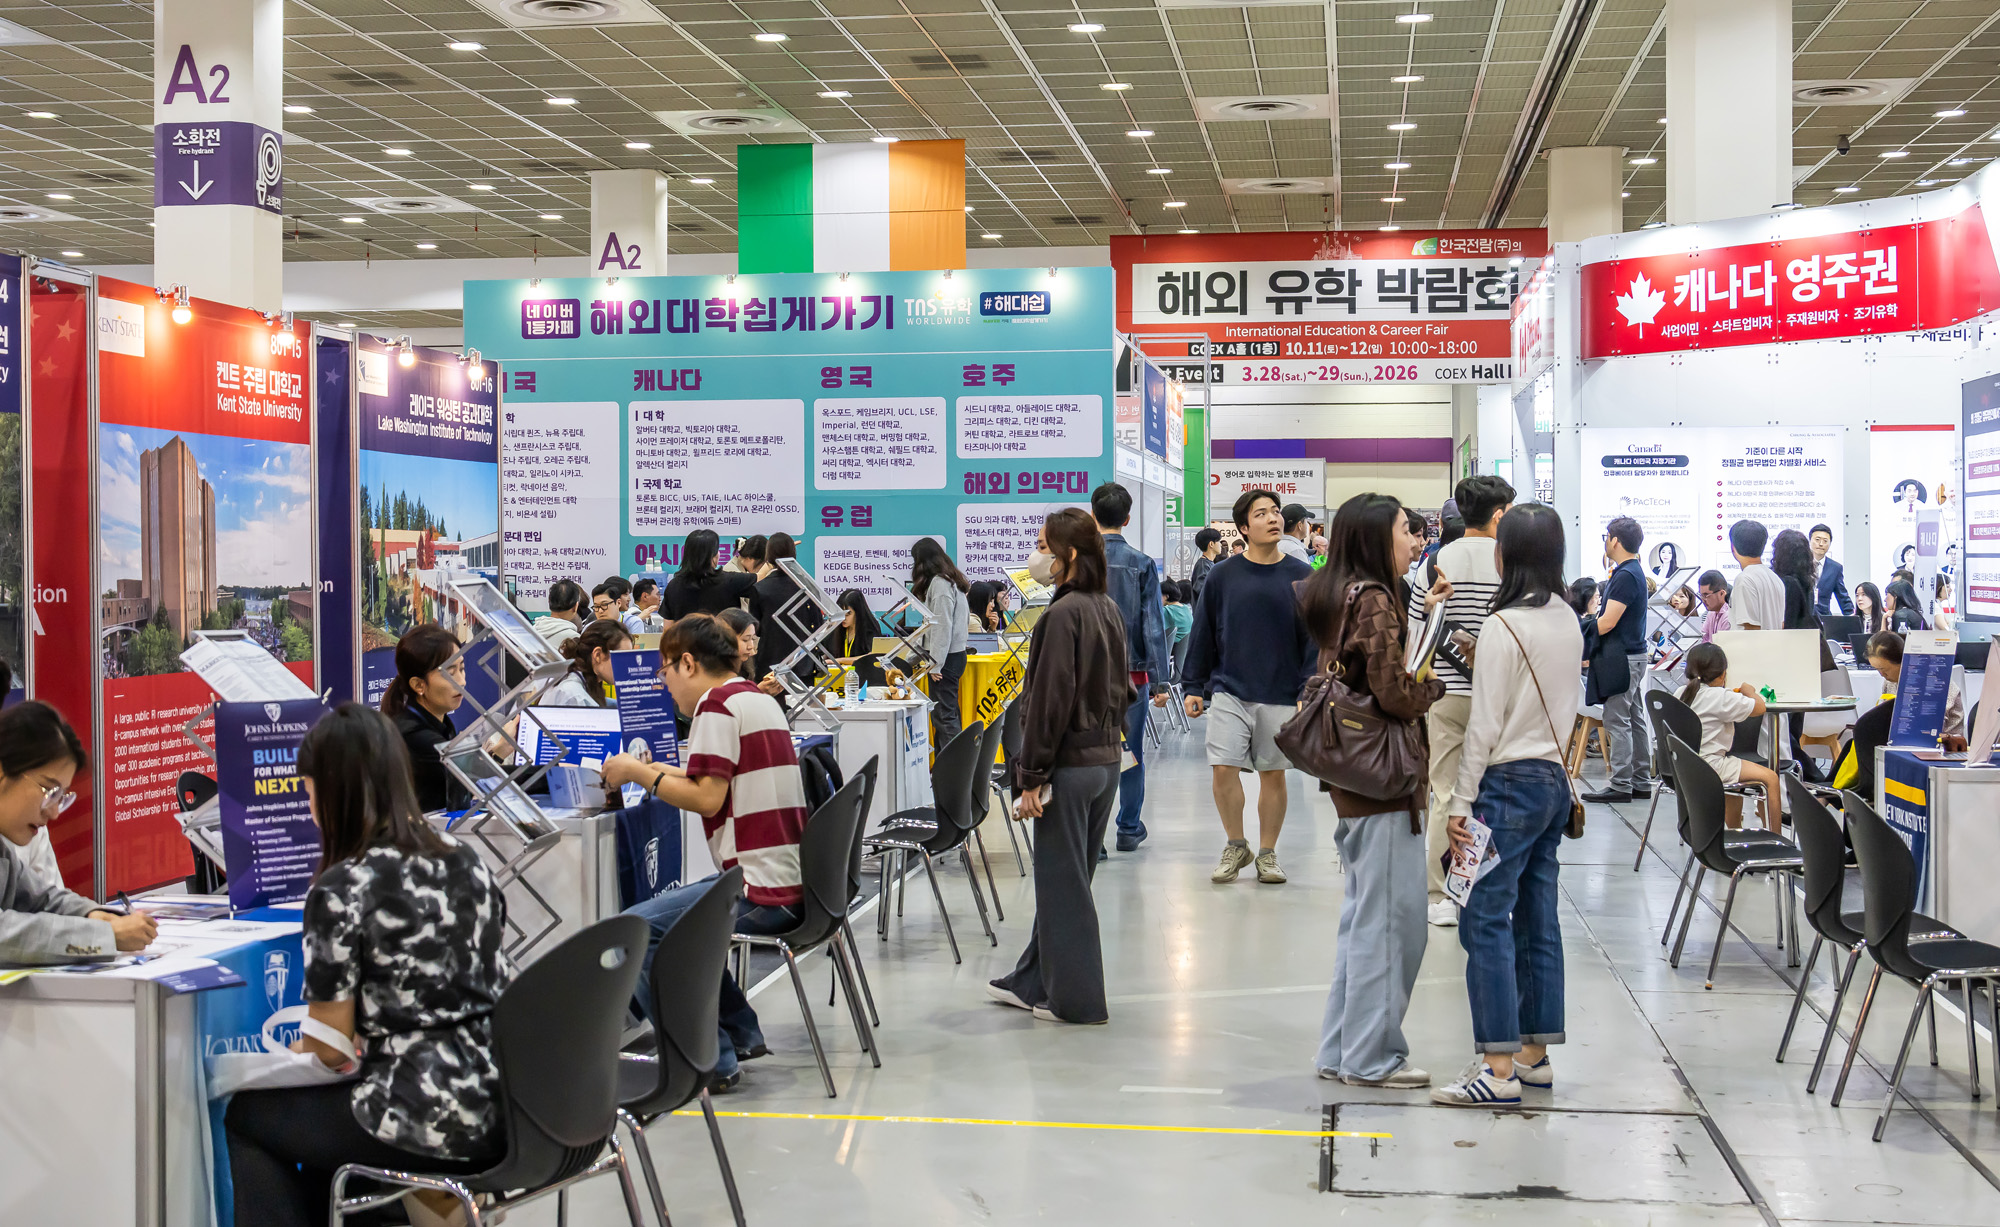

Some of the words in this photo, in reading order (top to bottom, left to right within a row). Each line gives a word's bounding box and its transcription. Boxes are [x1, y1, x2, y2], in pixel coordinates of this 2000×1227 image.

[163, 44, 230, 105] A2
[172, 128, 221, 147] 소화전
[191, 148, 214, 156] hydrant
[598, 231, 641, 270] A2
[1440, 238, 1522, 255] 한국전람(주)의
[1673, 259, 1777, 313] 캐나다
[1786, 245, 1898, 303] 영주권
[1157, 269, 1248, 317] 해외
[1266, 266, 1363, 316] 유학
[1377, 265, 1519, 314] 박람회
[590, 294, 894, 335] 해외대학쉽게가기
[904, 299, 937, 316] TNS
[940, 298, 973, 316] 유학
[906, 317, 971, 325] WORLDWIDE
[1661, 322, 1700, 338] 사업이민
[1712, 314, 1773, 334] 스타트업비자
[1786, 308, 1839, 326] 주재원비자
[1853, 302, 1898, 321] 조기유학
[526, 321, 574, 336] 1등카페
[1225, 325, 1302, 338] International
[1304, 323, 1367, 337] Education
[1368, 324, 1378, 336] &
[1380, 324, 1422, 337] Career
[1425, 323, 1449, 335] Fair
[1227, 343, 1247, 355] A홀
[1250, 342, 1278, 356] (1층)
[1389, 340, 1478, 355] 10:00~18:00
[217, 360, 240, 391] 켄트
[243, 366, 267, 395] 주립
[269, 370, 302, 399] 대학교
[1176, 367, 1220, 381] Evet
[1374, 365, 1418, 381] 2026
[1435, 368, 1467, 380] COEX
[1471, 363, 1504, 379] Hall
[633, 369, 702, 392] 캐나다
[217, 393, 237, 414] Kent
[238, 395, 261, 417] State
[263, 398, 303, 423] University
[409, 393, 435, 418] 레이크
[437, 397, 461, 423] 워싱턴
[462, 401, 493, 427] 공과대학
[822, 408, 854, 417] 옥스포드,
[856, 408, 896, 417] 케임브리지,
[898, 408, 917, 416] UCL,
[919, 407, 938, 416] LSE,
[964, 404, 987, 413] 시드니
[988, 404, 1013, 413] 대학교,
[1055, 403, 1081, 413] 대학교,
[822, 421, 859, 430] Imperial,
[861, 420, 876, 430] 런던
[877, 420, 903, 429] 대학교,
[964, 417, 994, 426] 그리피스
[996, 417, 1021, 426] 대학교,
[1023, 416, 1039, 426] 디킨
[1040, 416, 1066, 425] 대학교,
[377, 414, 394, 432] Lake
[394, 416, 428, 437] Washington
[429, 422, 455, 440] Institute
[455, 425, 463, 440] of
[463, 426, 493, 445] Technology
[503, 429, 525, 438] 시립대
[527, 429, 544, 438] 퀸즈,
[545, 429, 560, 437] 뉴욕
[561, 428, 586, 437] 주립대,
[635, 425, 658, 434] 알버타
[659, 425, 683, 434] 대학교,
[685, 425, 715, 433] 빅토리아
[716, 424, 741, 434] 대학교,
[822, 433, 852, 442] 맨체스터
[853, 433, 879, 442] 대학교,
[904, 432, 930, 441] 대학교,
[1627, 444, 1662, 453] Canada
[1745, 447, 1769, 456] 기준이
[1770, 446, 1786, 455] 다른
[1787, 446, 1803, 455] 시작
[1613, 457, 1632, 465] 캐나다
[1746, 458, 1777, 467] 법무법인
[1778, 458, 1802, 467] 차별화
[1803, 458, 1827, 467] 서비스
[1224, 470, 1245, 479] 영어로
[1247, 470, 1275, 479] 입학하는
[1276, 470, 1290, 478] 일본
[1292, 470, 1313, 478] 명문대
[642, 478, 662, 490] 국제
[663, 478, 682, 490] 학교
[963, 471, 1010, 495] 해외
[1017, 471, 1088, 494] 의약대
[1275, 482, 1297, 494] 에듀
[636, 494, 658, 502] 토론토
[659, 494, 681, 503] BICC,
[683, 494, 699, 503] UIS,
[701, 494, 722, 502] TAIE,
[724, 493, 742, 501] ILAC
[744, 493, 776, 502] 하이스쿨,
[965, 516, 983, 524] SGU
[984, 515, 1000, 524] 의과
[1001, 515, 1019, 524] 대학,
[823, 549, 863, 558] 암스테르담,
[865, 549, 890, 558] 트벤테,
[823, 563, 852, 571] KEDGE
[853, 562, 891, 571] Business
[823, 575, 851, 584] LISAA,
[853, 575, 873, 584] SRH,
[995, 666, 1017, 694] 유학
[244, 723, 271, 737] JOHNS
[272, 721, 308, 734] HOPKINS
[114, 745, 128, 758] 2000
[128, 740, 160, 755] international
[161, 738, 182, 752] students
[114, 761, 126, 773] Over
[127, 760, 138, 771] 300
[138, 757, 161, 770] academic
[162, 753, 184, 767] programs
[184, 752, 191, 761] at
[254, 766, 272, 778] FOR
[114, 774, 149, 790] Opportunities
[115, 810, 132, 823] Global
[132, 804, 161, 819] Scholarship
